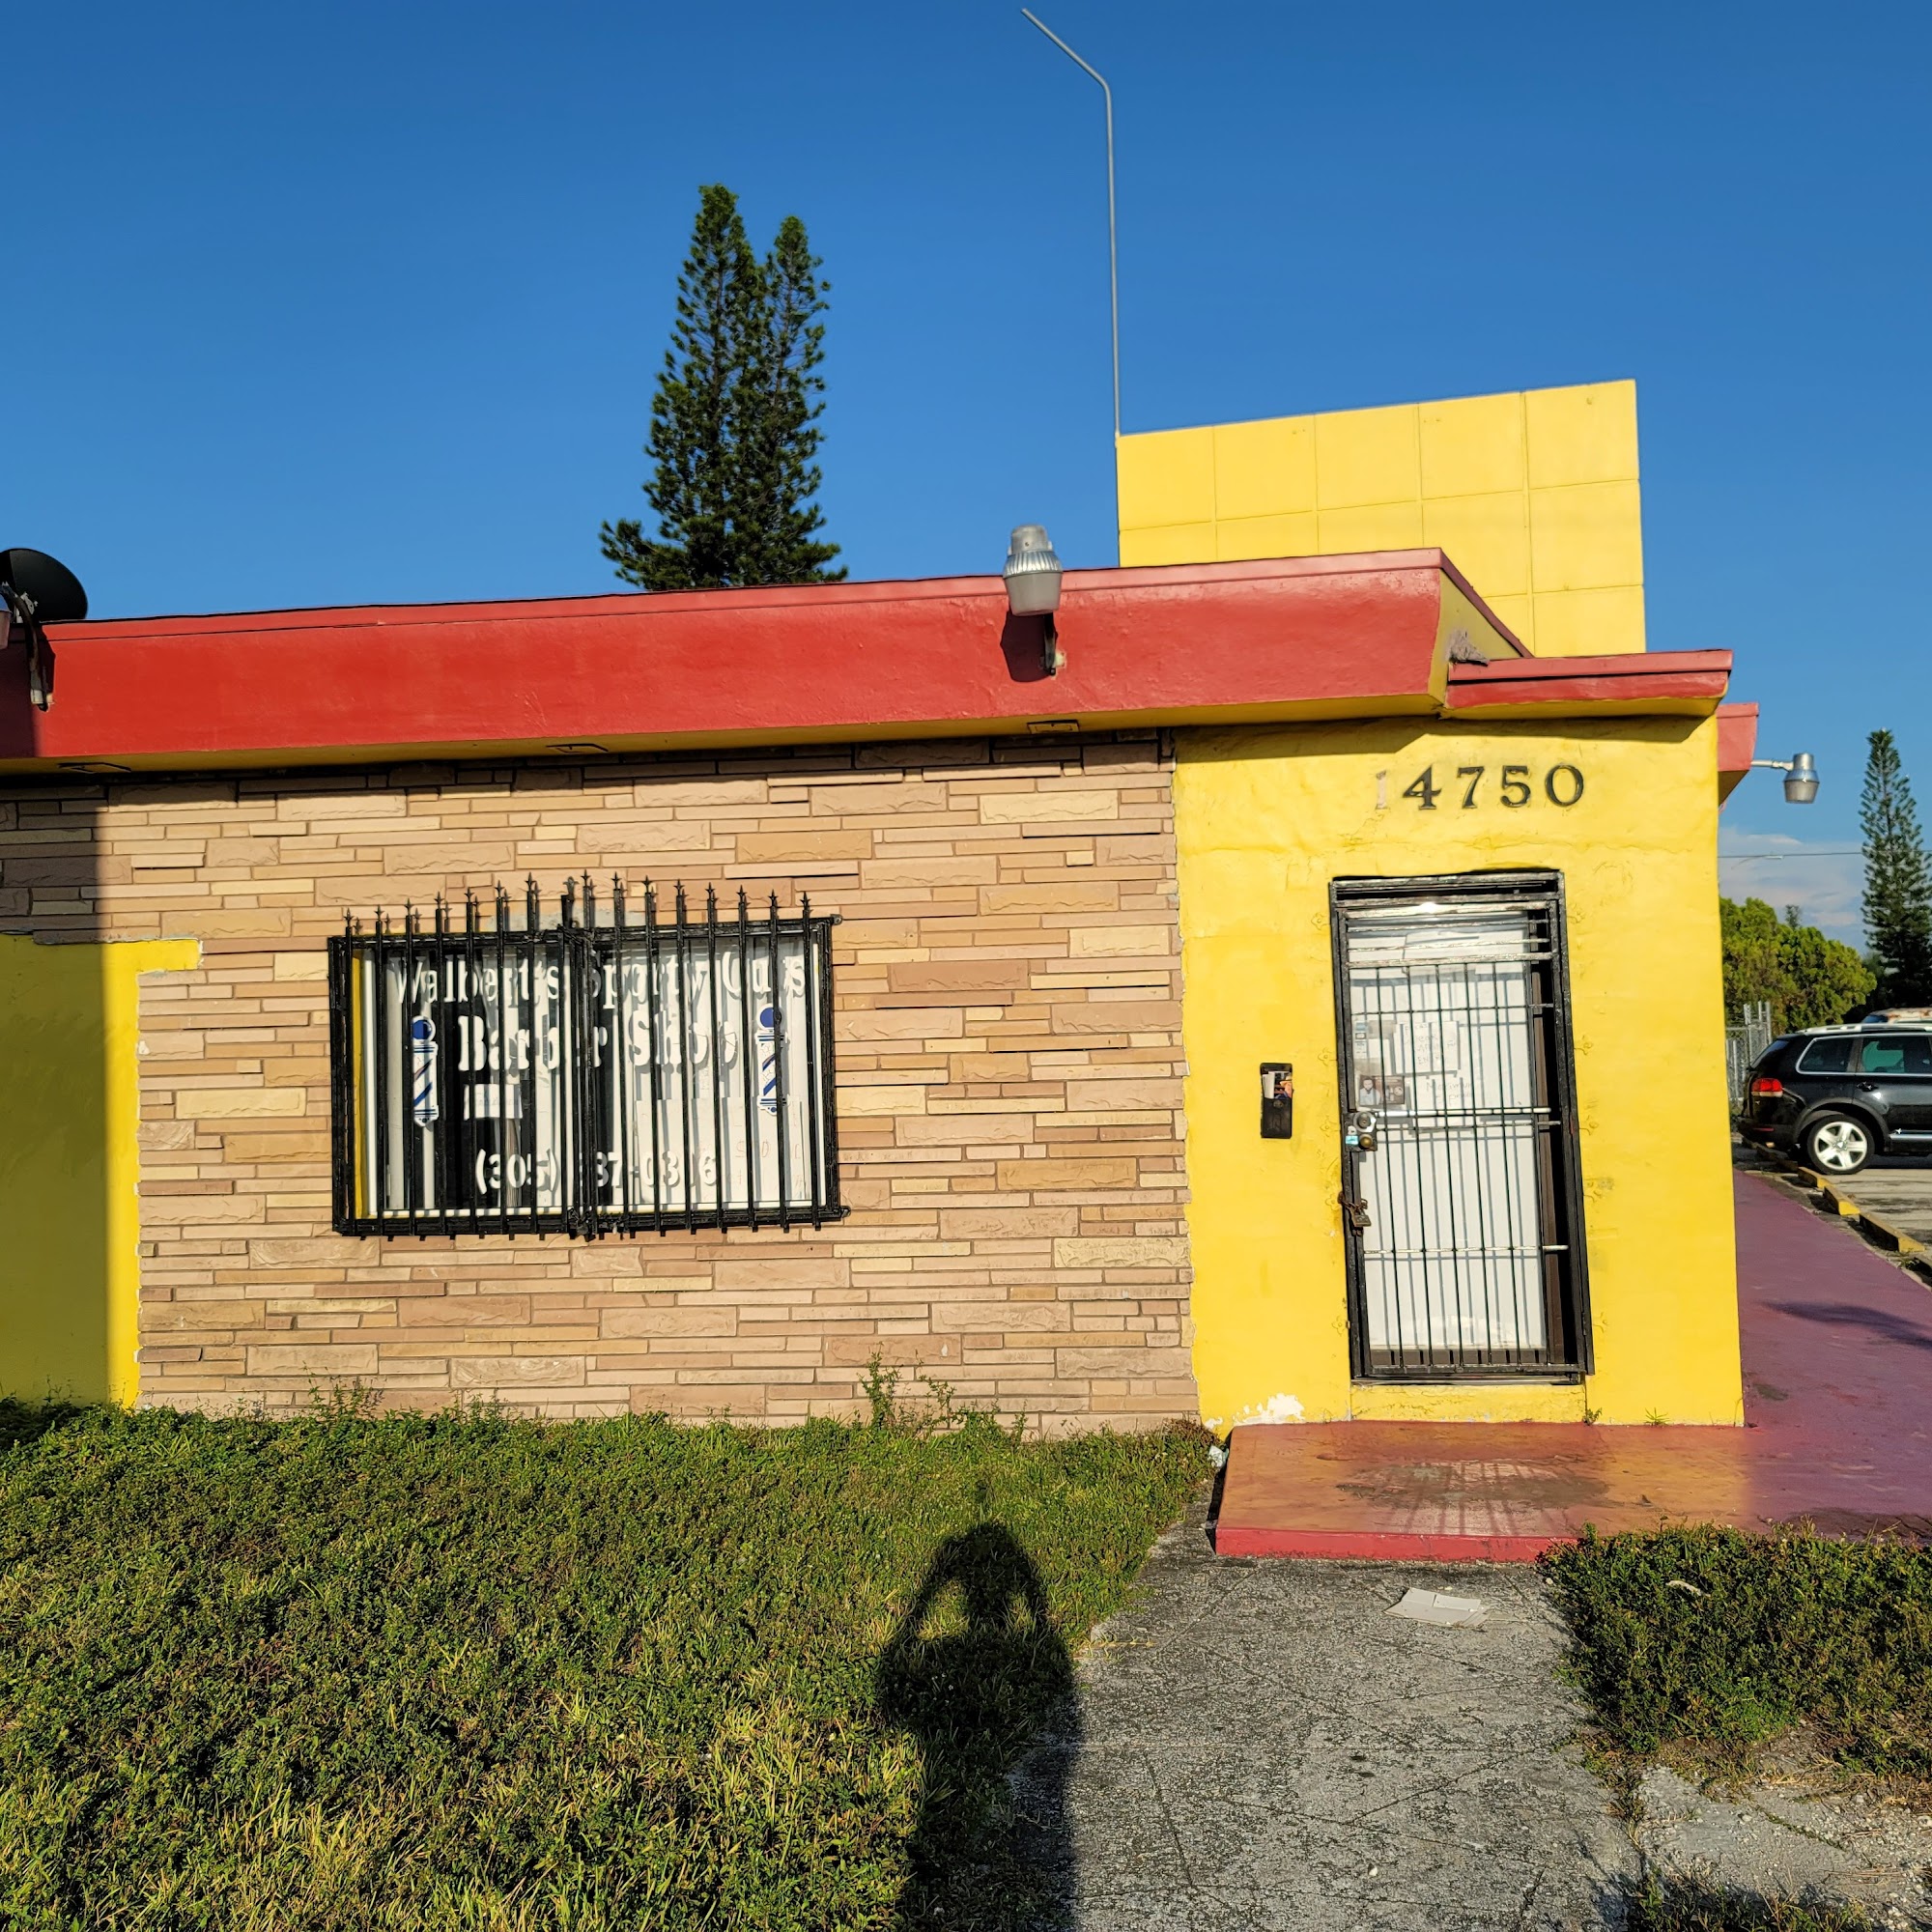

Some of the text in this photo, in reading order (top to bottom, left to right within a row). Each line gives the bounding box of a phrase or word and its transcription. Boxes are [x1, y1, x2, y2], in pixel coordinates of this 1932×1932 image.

[722, 952, 806, 997] Cus
[458, 1014, 609, 1071] Barbr
[474, 1148, 718, 1193] (305) 87-036
